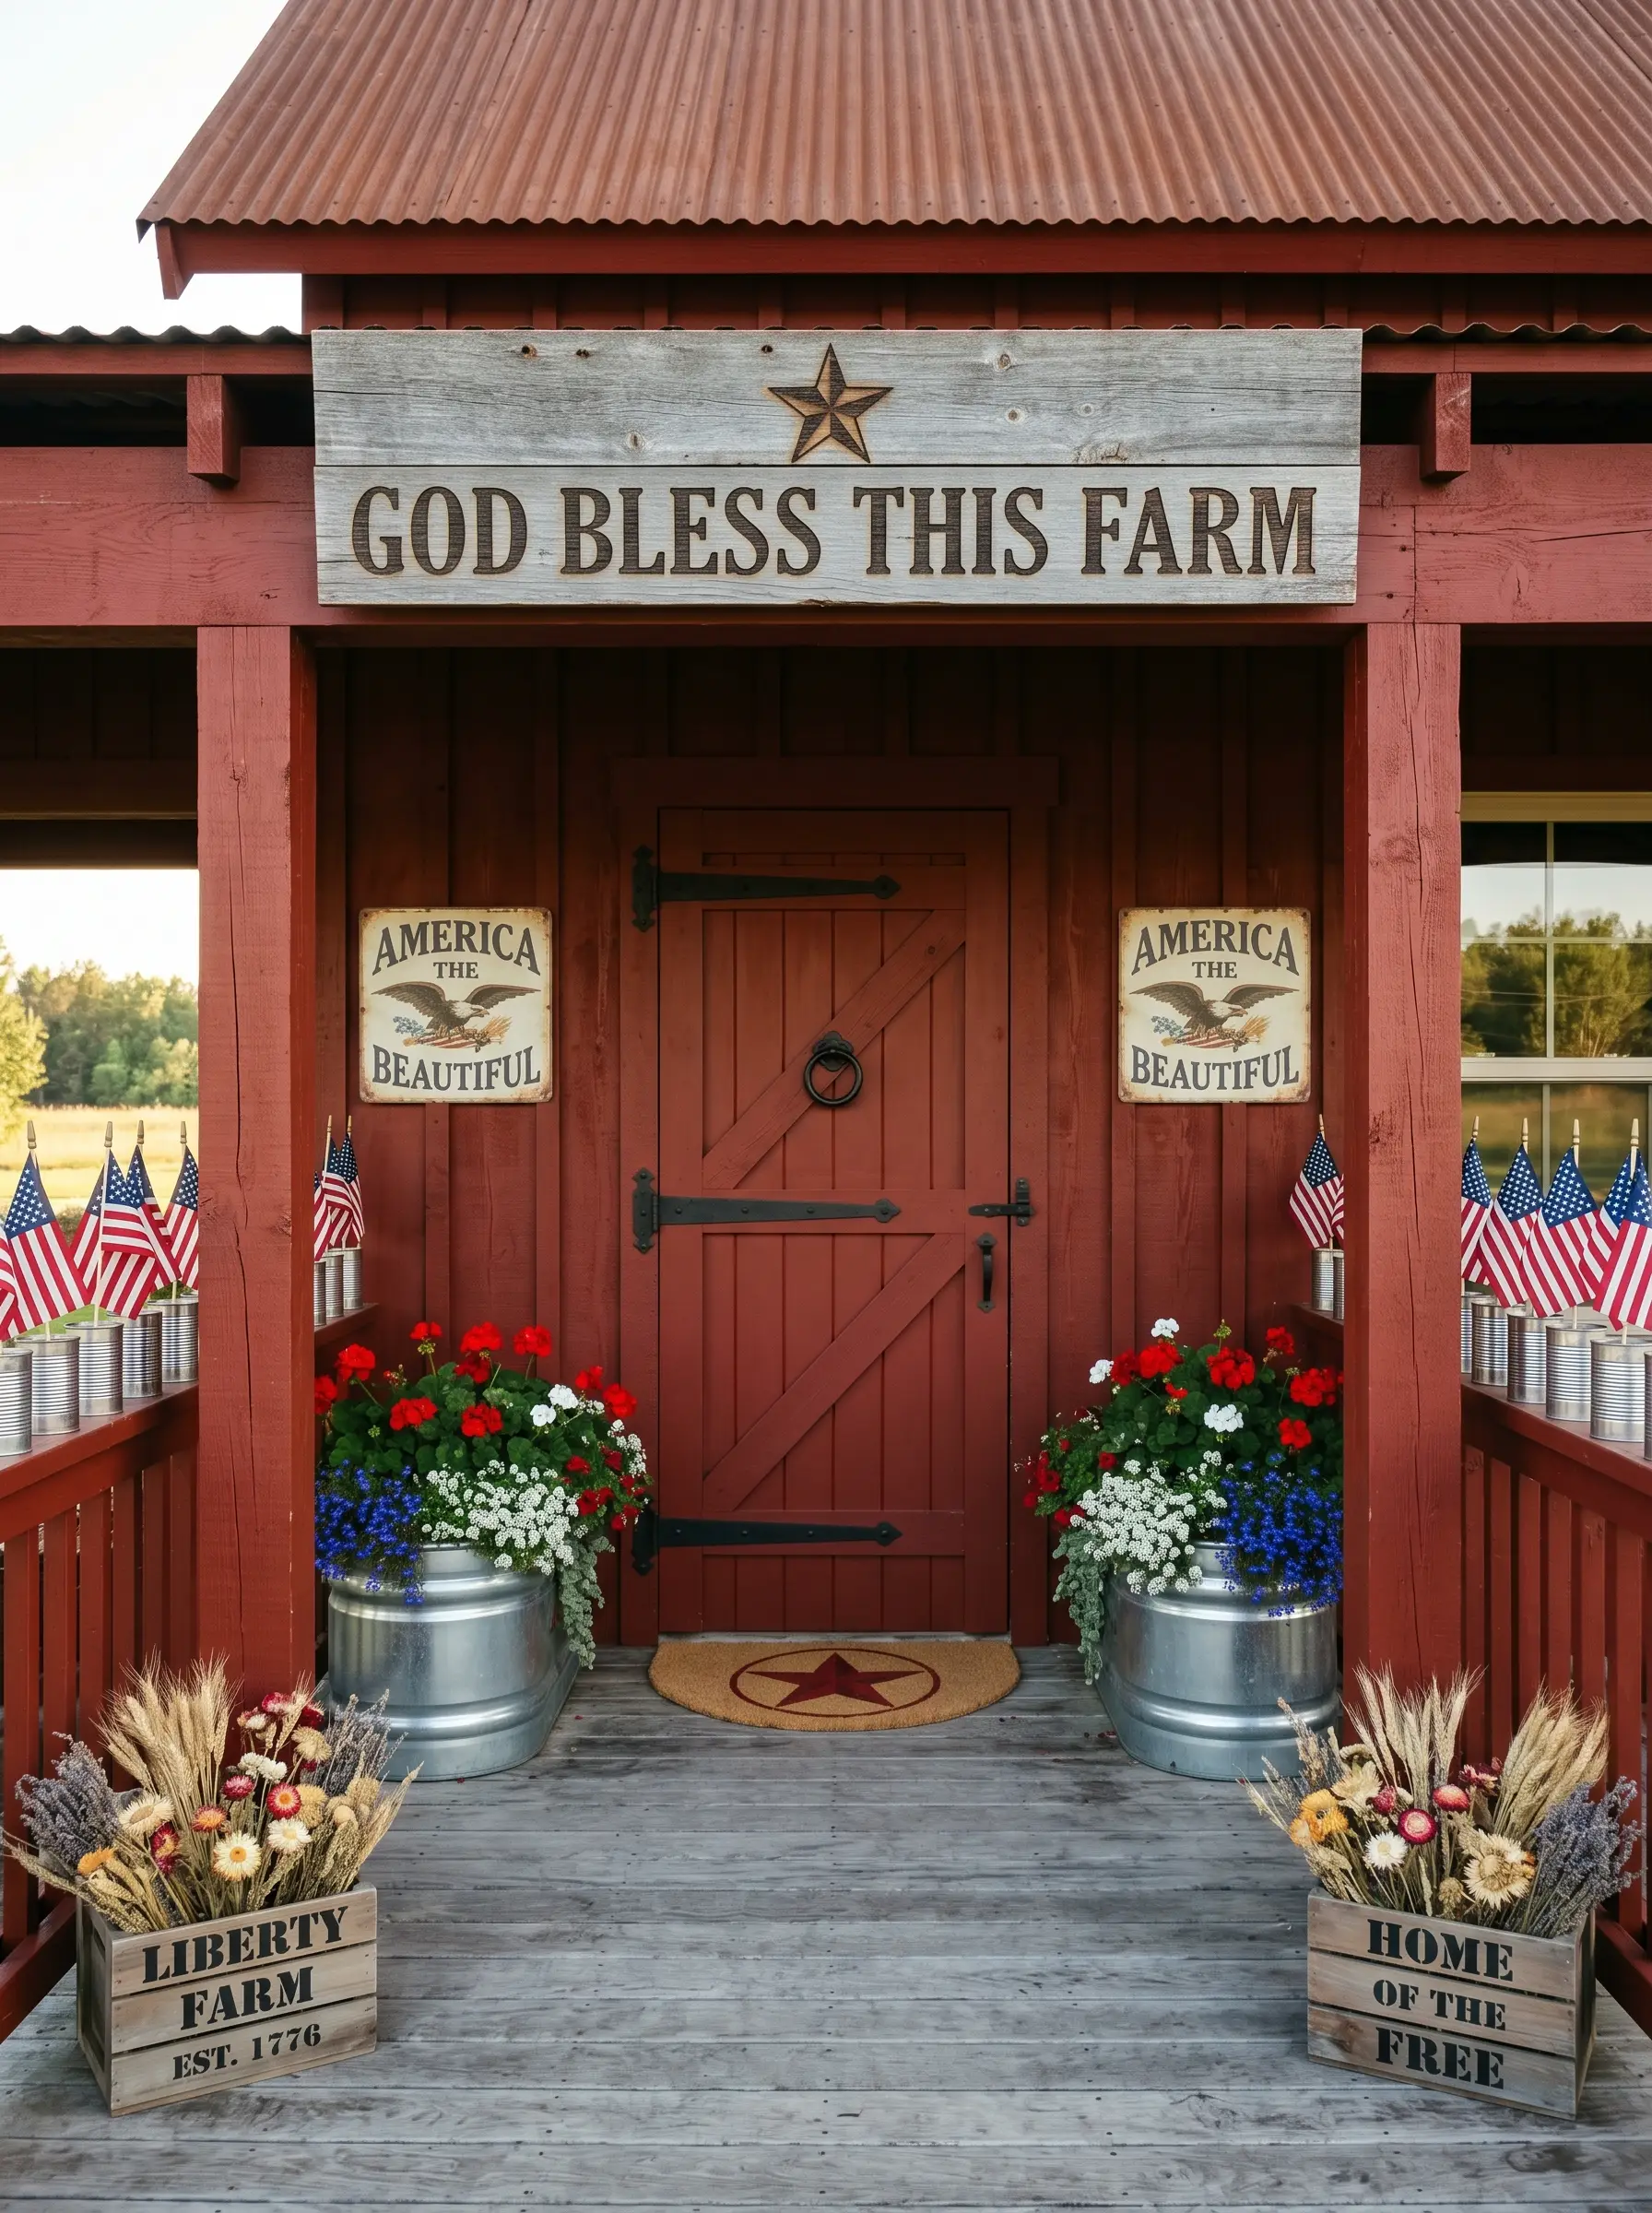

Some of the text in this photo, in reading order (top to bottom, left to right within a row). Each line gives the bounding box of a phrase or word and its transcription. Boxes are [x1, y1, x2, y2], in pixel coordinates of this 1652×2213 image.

[351, 486, 1317, 576] GOD BLESS THIS FARM
[372, 919, 541, 976] AMERICA
[433, 962, 478, 978] THE
[1131, 919, 1300, 976] AMERICA
[1192, 961, 1237, 978] THE
[372, 1044, 541, 1091] BEAUTIFUL
[1131, 1045, 1299, 1091] BEAUTIFUL
[142, 1905, 348, 1983] LIBERTY
[1367, 1918, 1514, 1982] HOME
[180, 1966, 313, 2030] FARM
[1373, 1979, 1506, 2031] OF THE
[172, 2023, 321, 2080] EST. 1776
[1375, 2027, 1504, 2090] FREE
